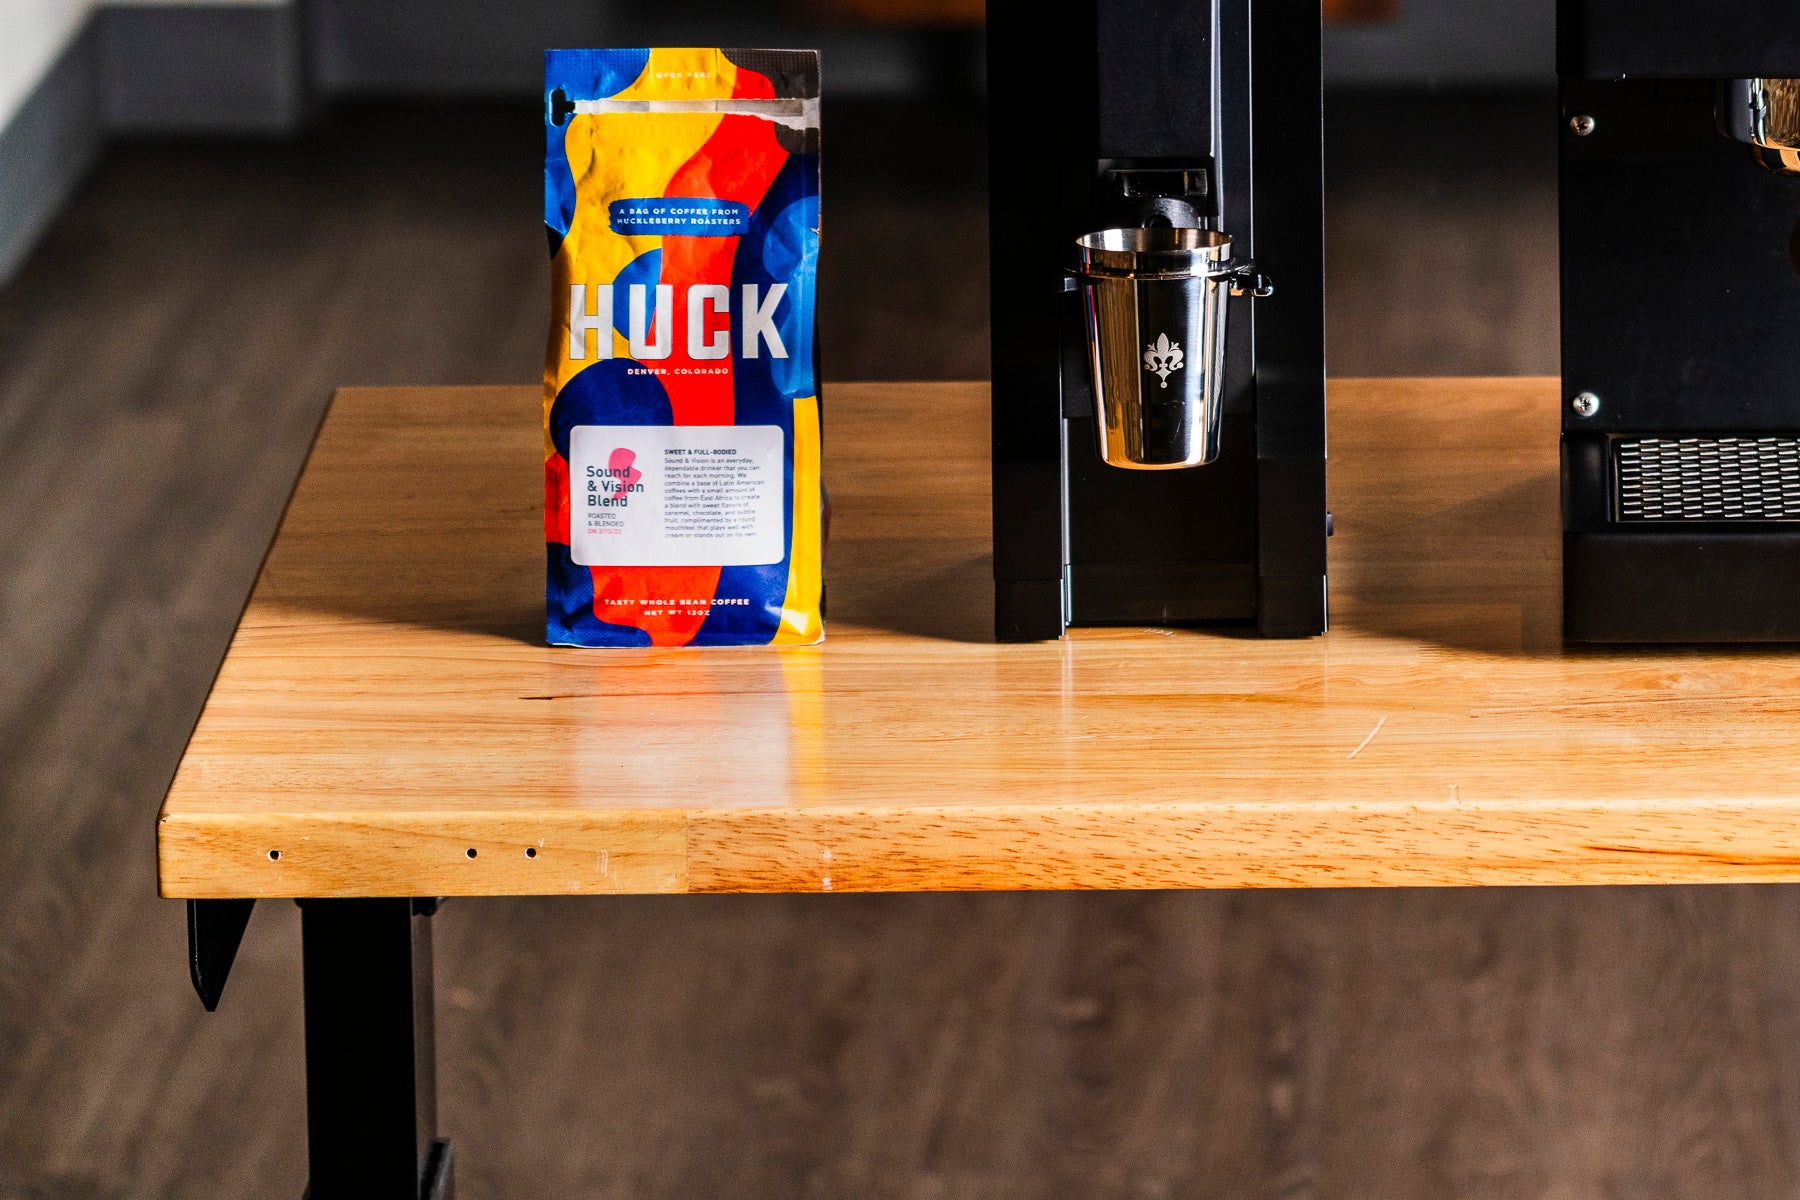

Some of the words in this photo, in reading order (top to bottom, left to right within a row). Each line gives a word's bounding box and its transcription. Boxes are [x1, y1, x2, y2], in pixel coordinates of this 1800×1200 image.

[569, 283, 789, 360] HUCK
[627, 368, 670, 376] DENVER,
[674, 367, 729, 375] COLORADO
[726, 457, 754, 465] everyday,
[586, 465, 630, 478] Sound
[587, 480, 598, 492] &
[601, 480, 644, 493] Vision
[587, 494, 628, 507] Blend
[605, 598, 635, 606] TASTY
[639, 598, 675, 606] WHOLE
